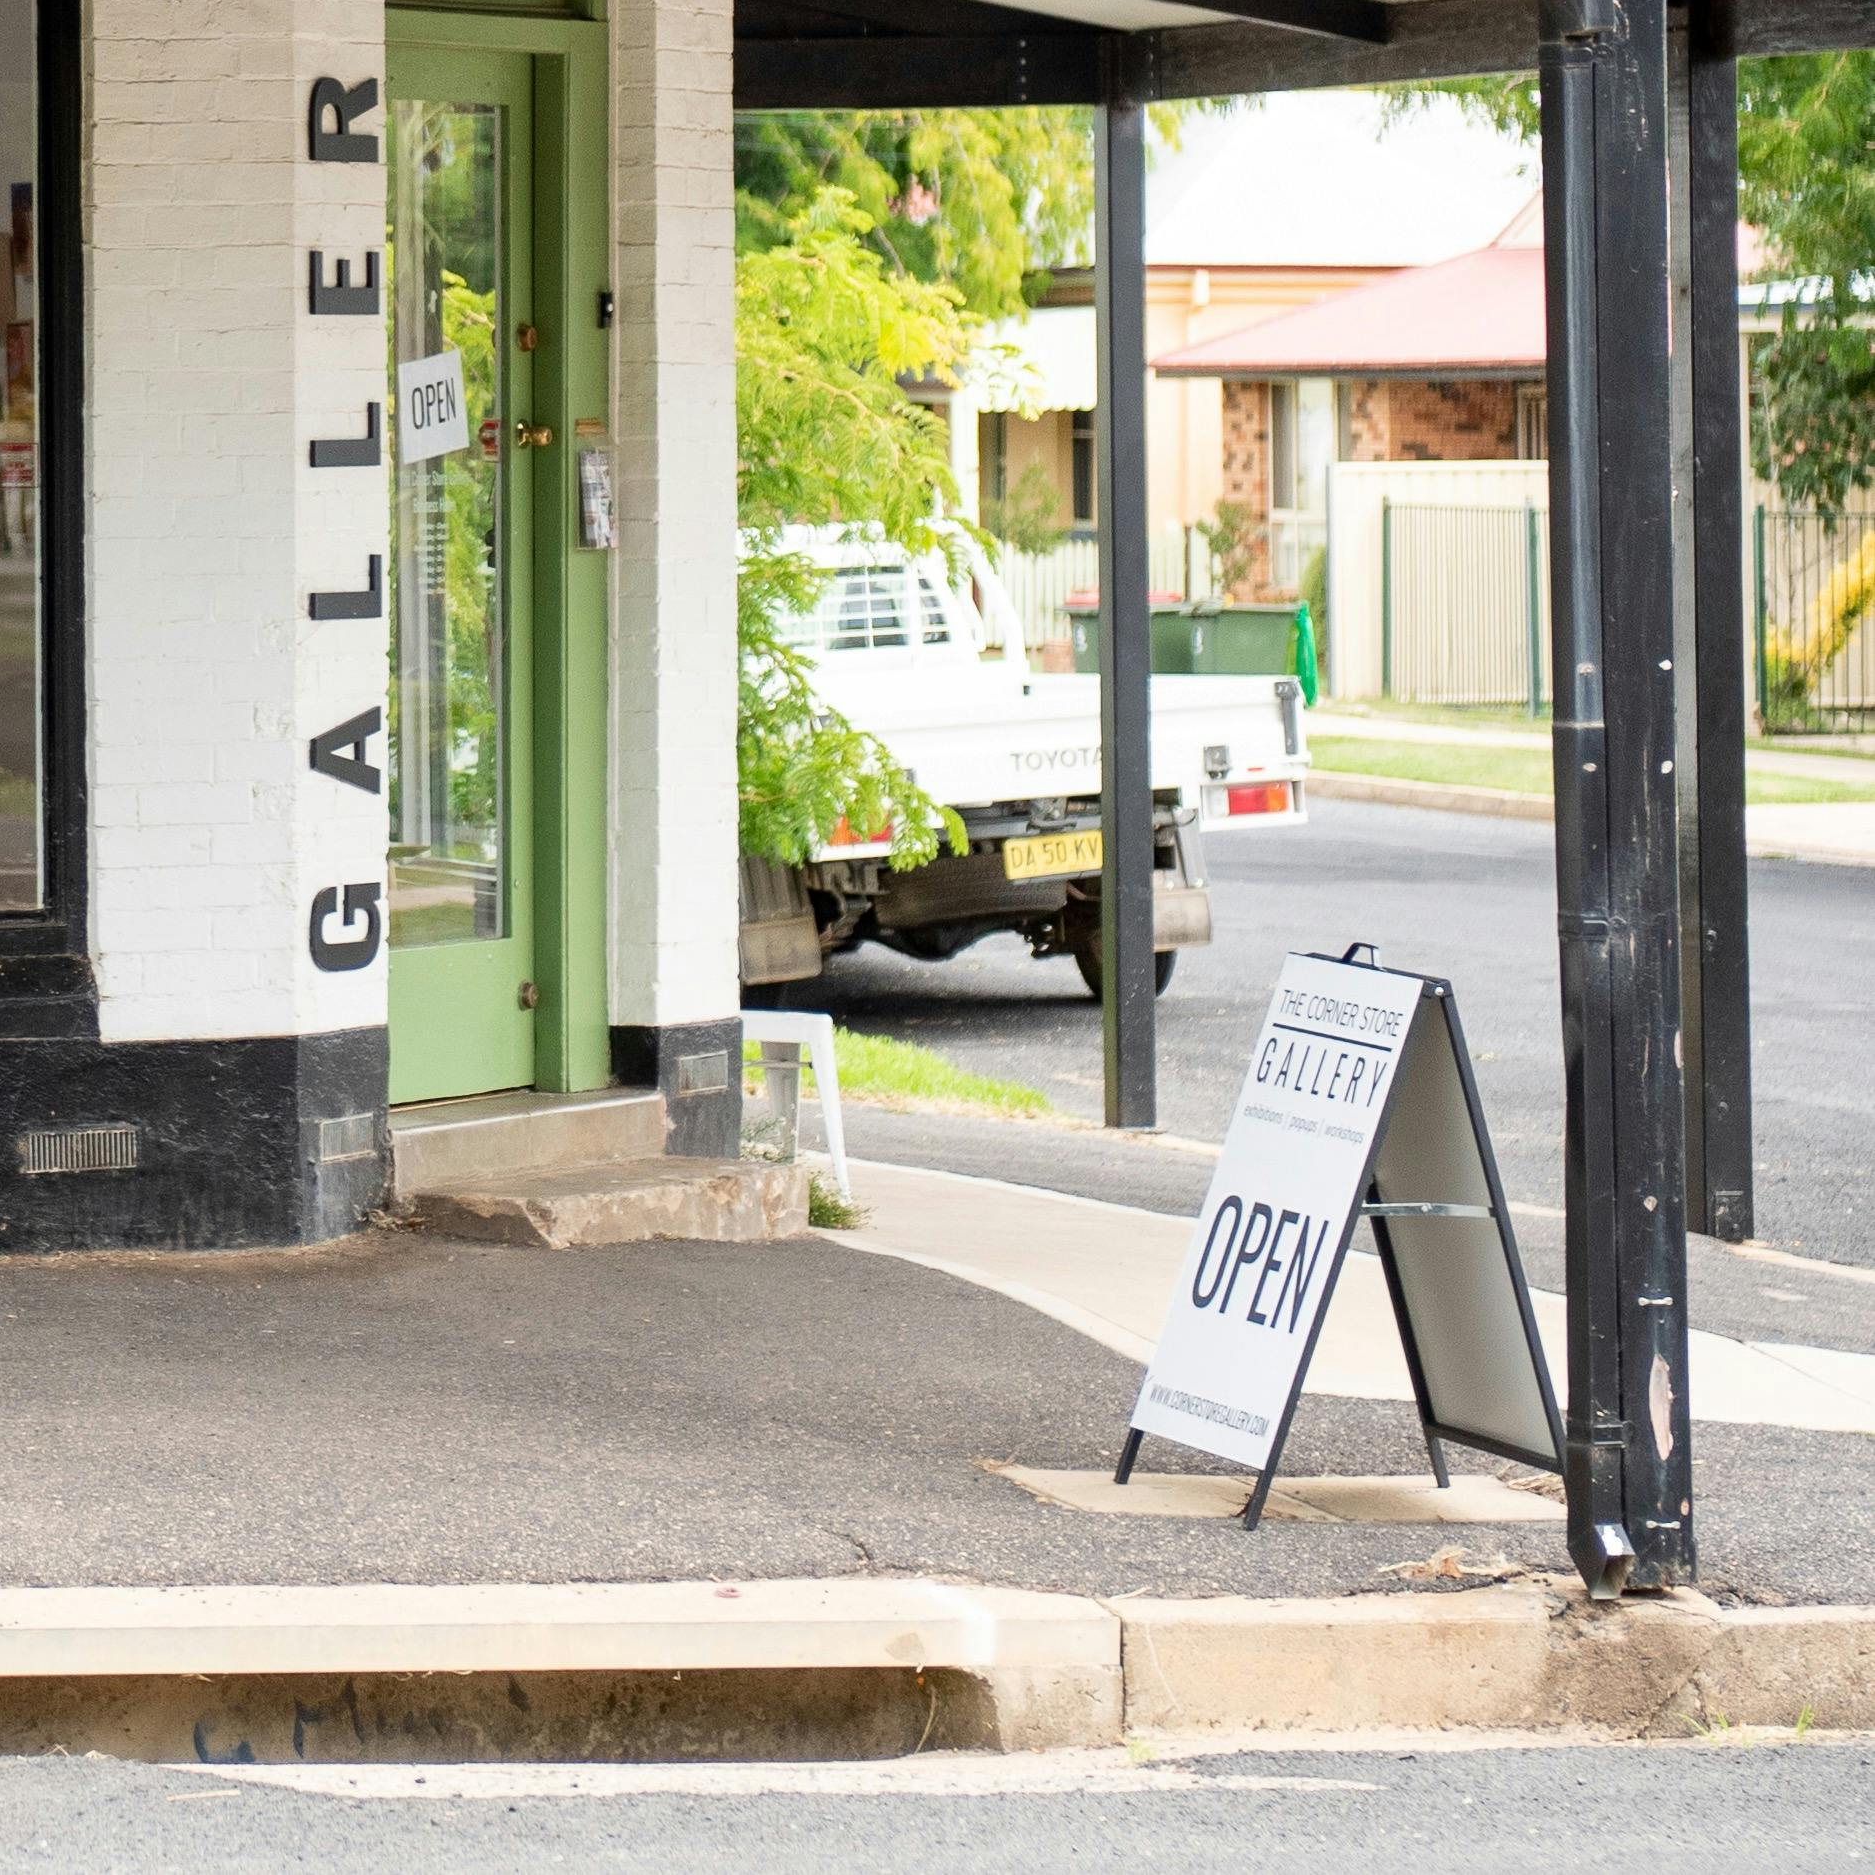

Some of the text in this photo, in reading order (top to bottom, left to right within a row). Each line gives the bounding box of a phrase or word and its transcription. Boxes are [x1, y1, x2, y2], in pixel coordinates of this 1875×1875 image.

[412, 377, 457, 430] OPEN
[1042, 841, 1067, 866] 50
[1074, 836, 1098, 861] KV
[1279, 989, 1403, 1037] THE CORNER STORE
[1256, 1037, 1388, 1108] GALLERY
[1243, 1103, 1366, 1146] exhibitions popups workshops
[1192, 1195, 1329, 1334] OPEN
